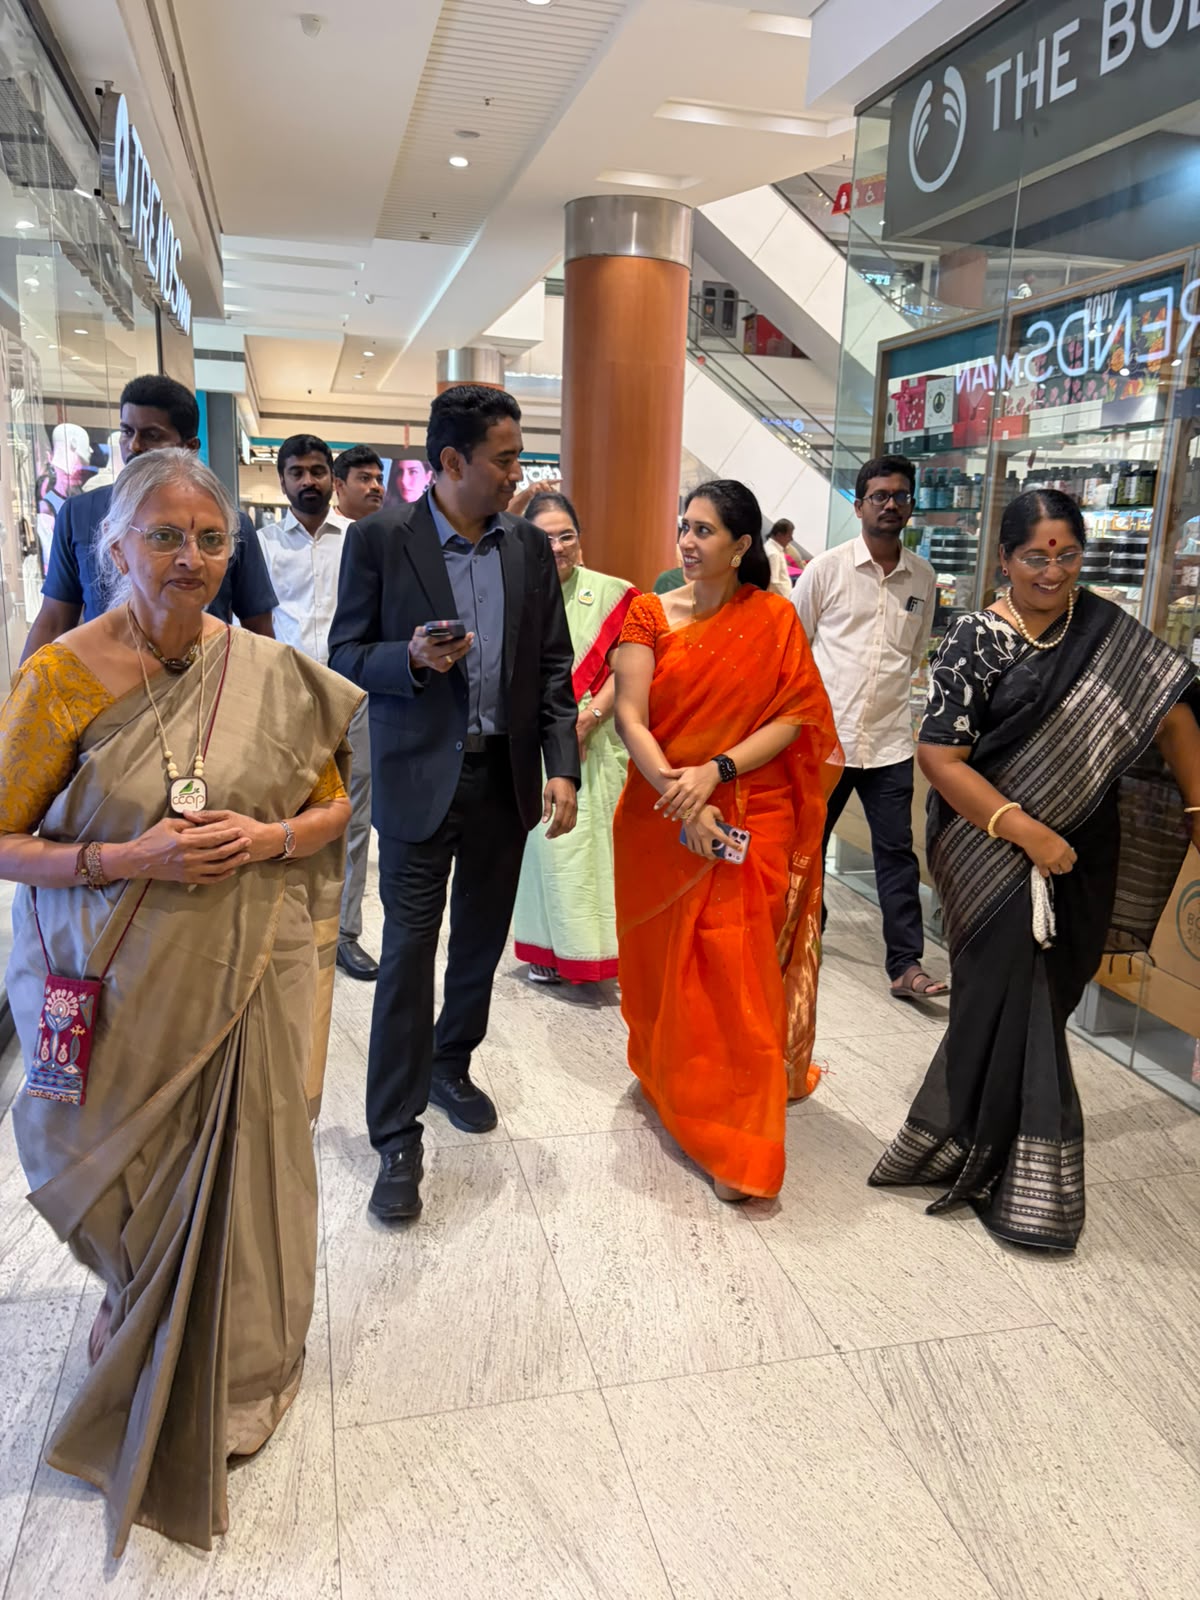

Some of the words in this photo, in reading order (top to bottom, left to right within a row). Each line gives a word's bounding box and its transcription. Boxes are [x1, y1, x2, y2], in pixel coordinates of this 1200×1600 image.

[986, 18, 1080, 132] THE
[1099, 0, 1200, 76] BO
[131, 124, 182, 314] TRENDS
